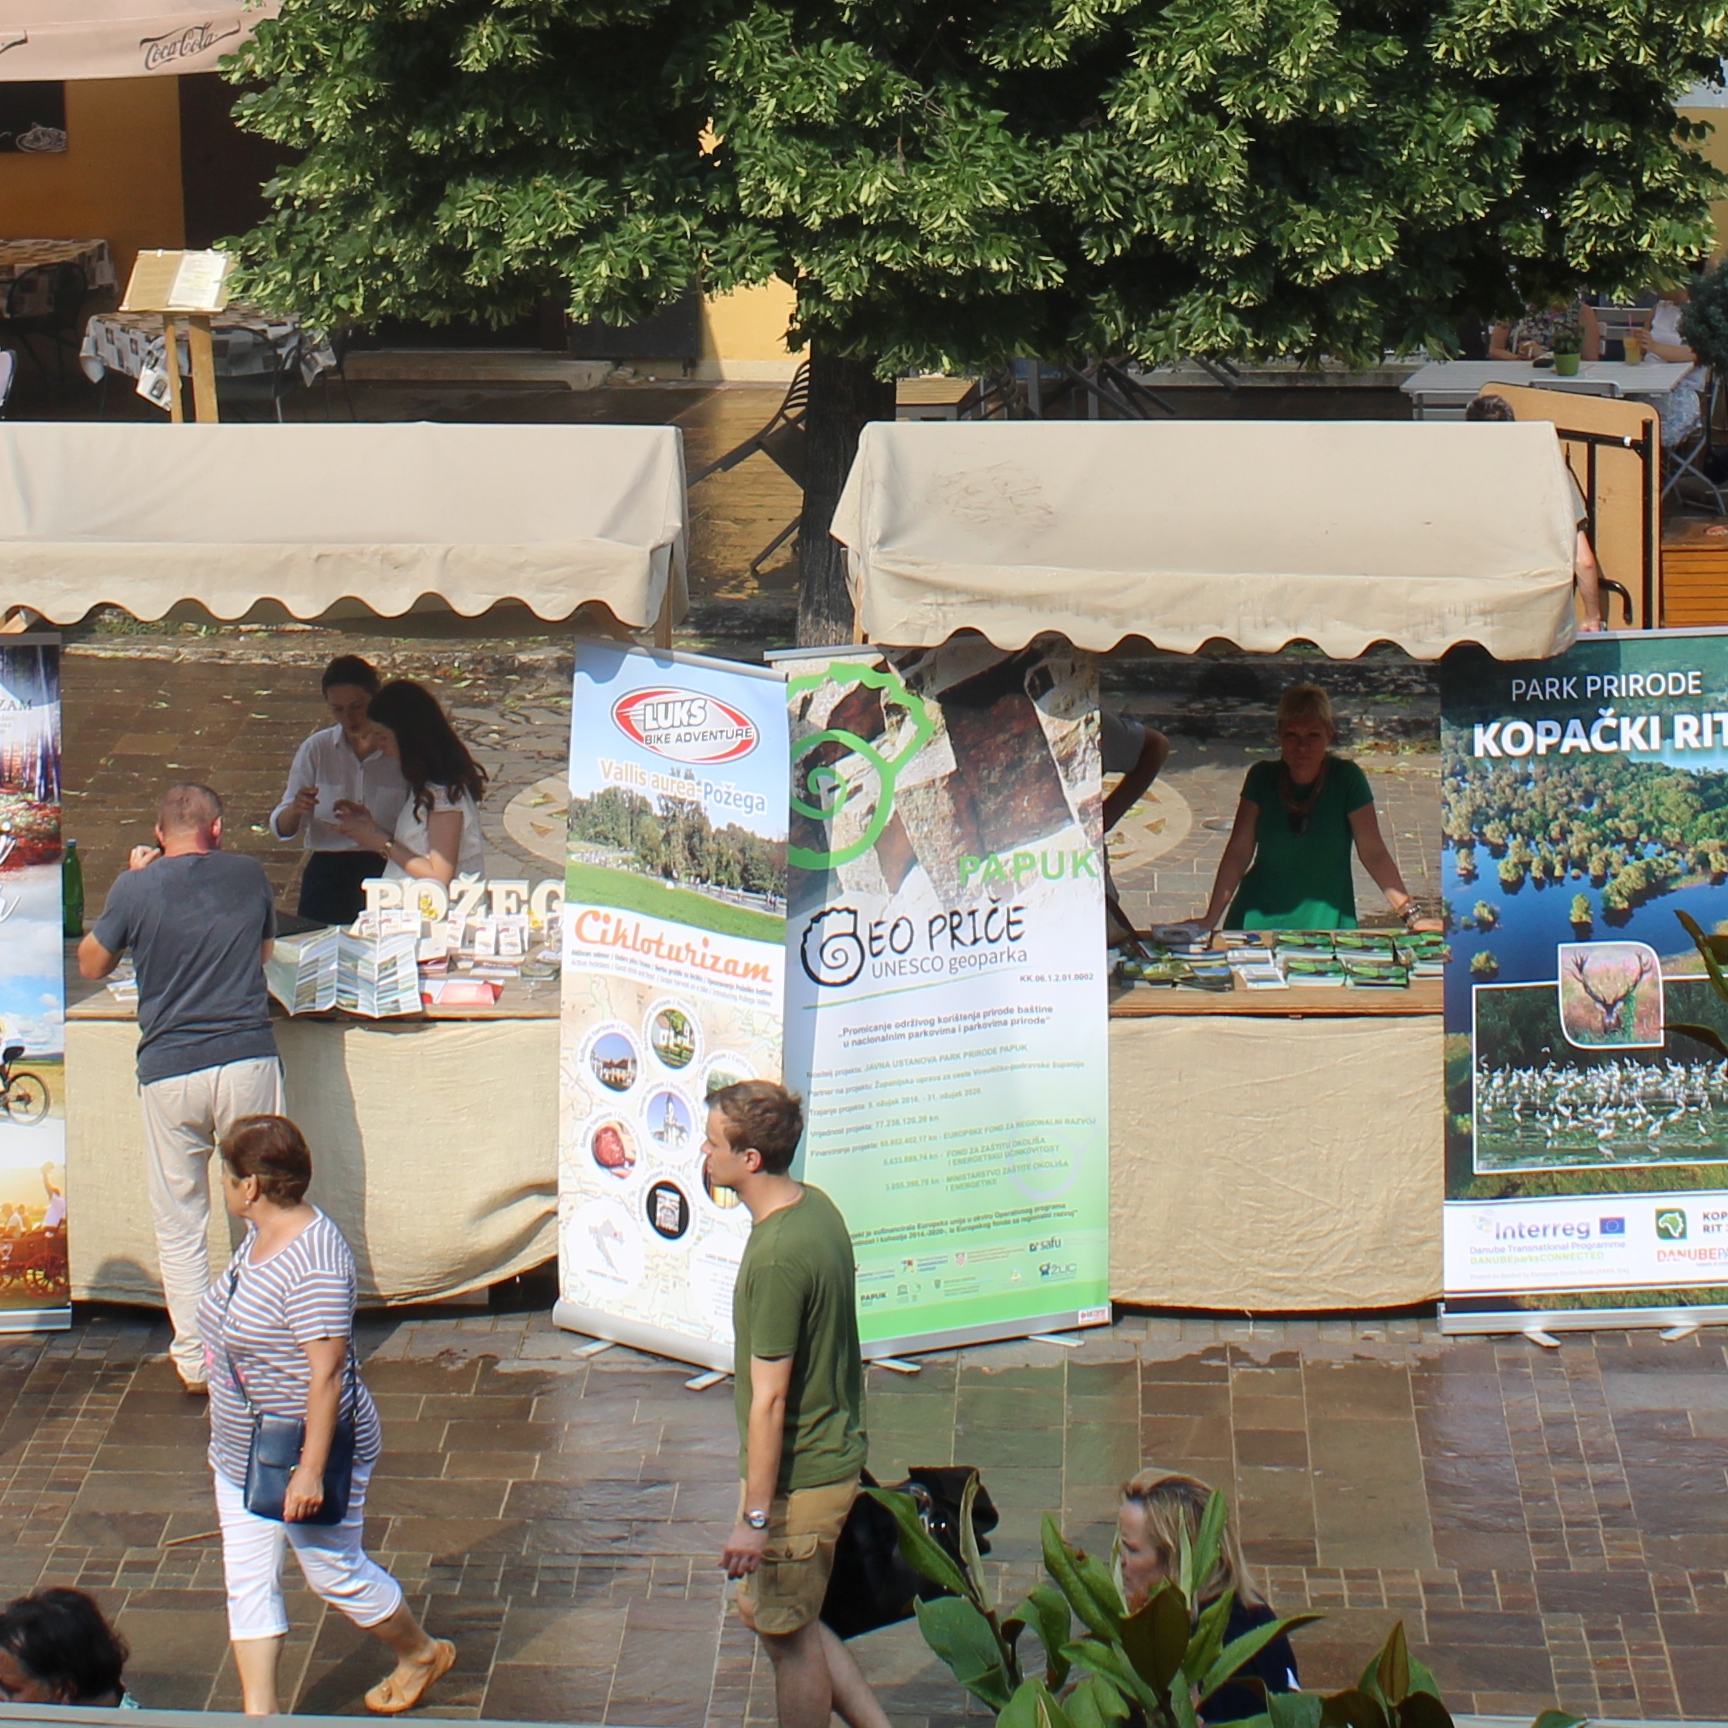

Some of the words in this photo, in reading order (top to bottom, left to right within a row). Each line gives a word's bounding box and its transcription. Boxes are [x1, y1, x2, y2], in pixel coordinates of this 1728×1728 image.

[139, 20, 241, 70] Coca-Cola
[1512, 676, 1579, 702] PARK
[1586, 671, 1704, 698] PRIRODE
[643, 698, 707, 731] LUKS
[644, 732, 671, 746] BIKE
[675, 727, 753, 744] ADVENTURE
[1473, 707, 1663, 759] KOPAČKI
[600, 759, 647, 786] Vallis
[960, 848, 1099, 886] PAPUK
[929, 897, 1027, 952] PRIČE
[575, 910, 773, 983] Cikloturizam
[872, 955, 944, 979] UNESCO
[949, 947, 1027, 975] geoparka
[1040, 1235, 1061, 1250] safu
[1495, 1221, 1591, 1240] Interreg
[1703, 1223, 1722, 1233] RIT
[1470, 1245, 1505, 1255] Danube
[1508, 1242, 1569, 1254] Transnational
[1572, 1240, 1626, 1252] Programme
